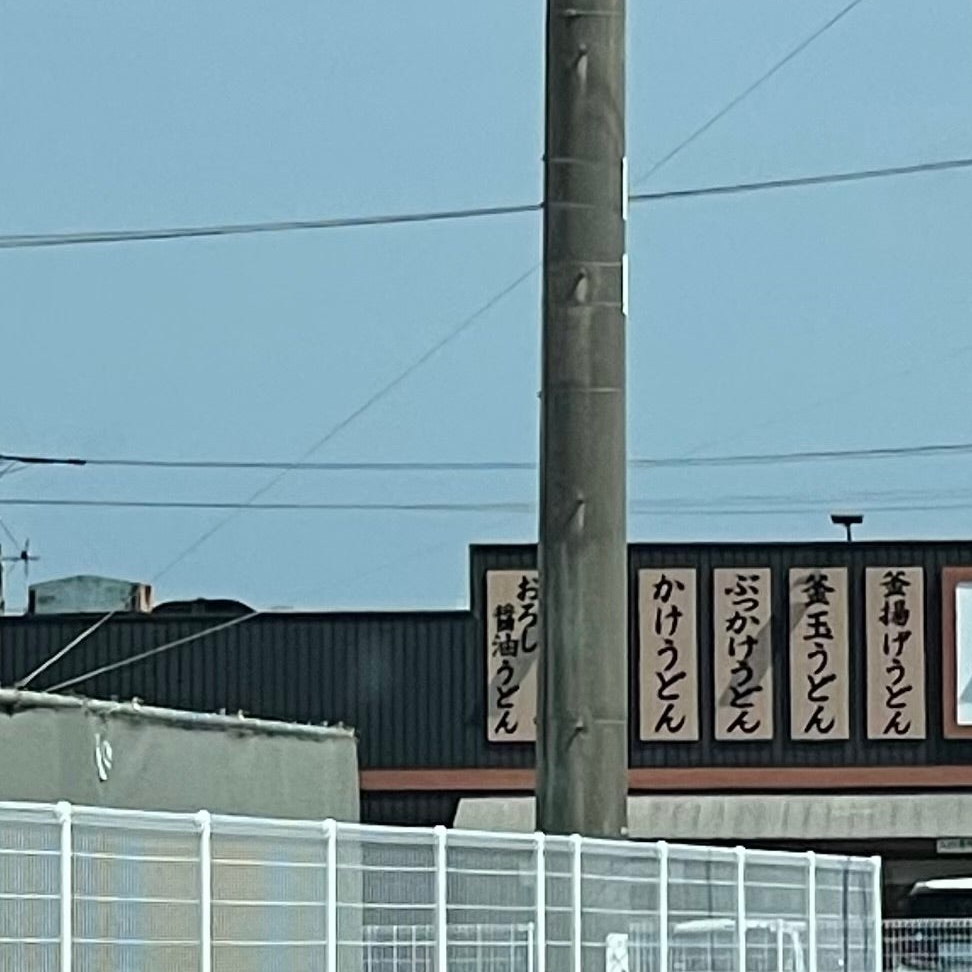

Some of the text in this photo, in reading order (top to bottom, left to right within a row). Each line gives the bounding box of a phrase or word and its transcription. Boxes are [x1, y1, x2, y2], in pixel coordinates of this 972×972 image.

[492, 603, 520, 734] 醤油うどん
[517, 575, 539, 653] おろし
[652, 573, 687, 734] かけうどん
[724, 574, 763, 734] ぶっかけうどん
[802, 573, 836, 734] 釜玉うどん
[879, 571, 913, 735] 釜揚げうどん
